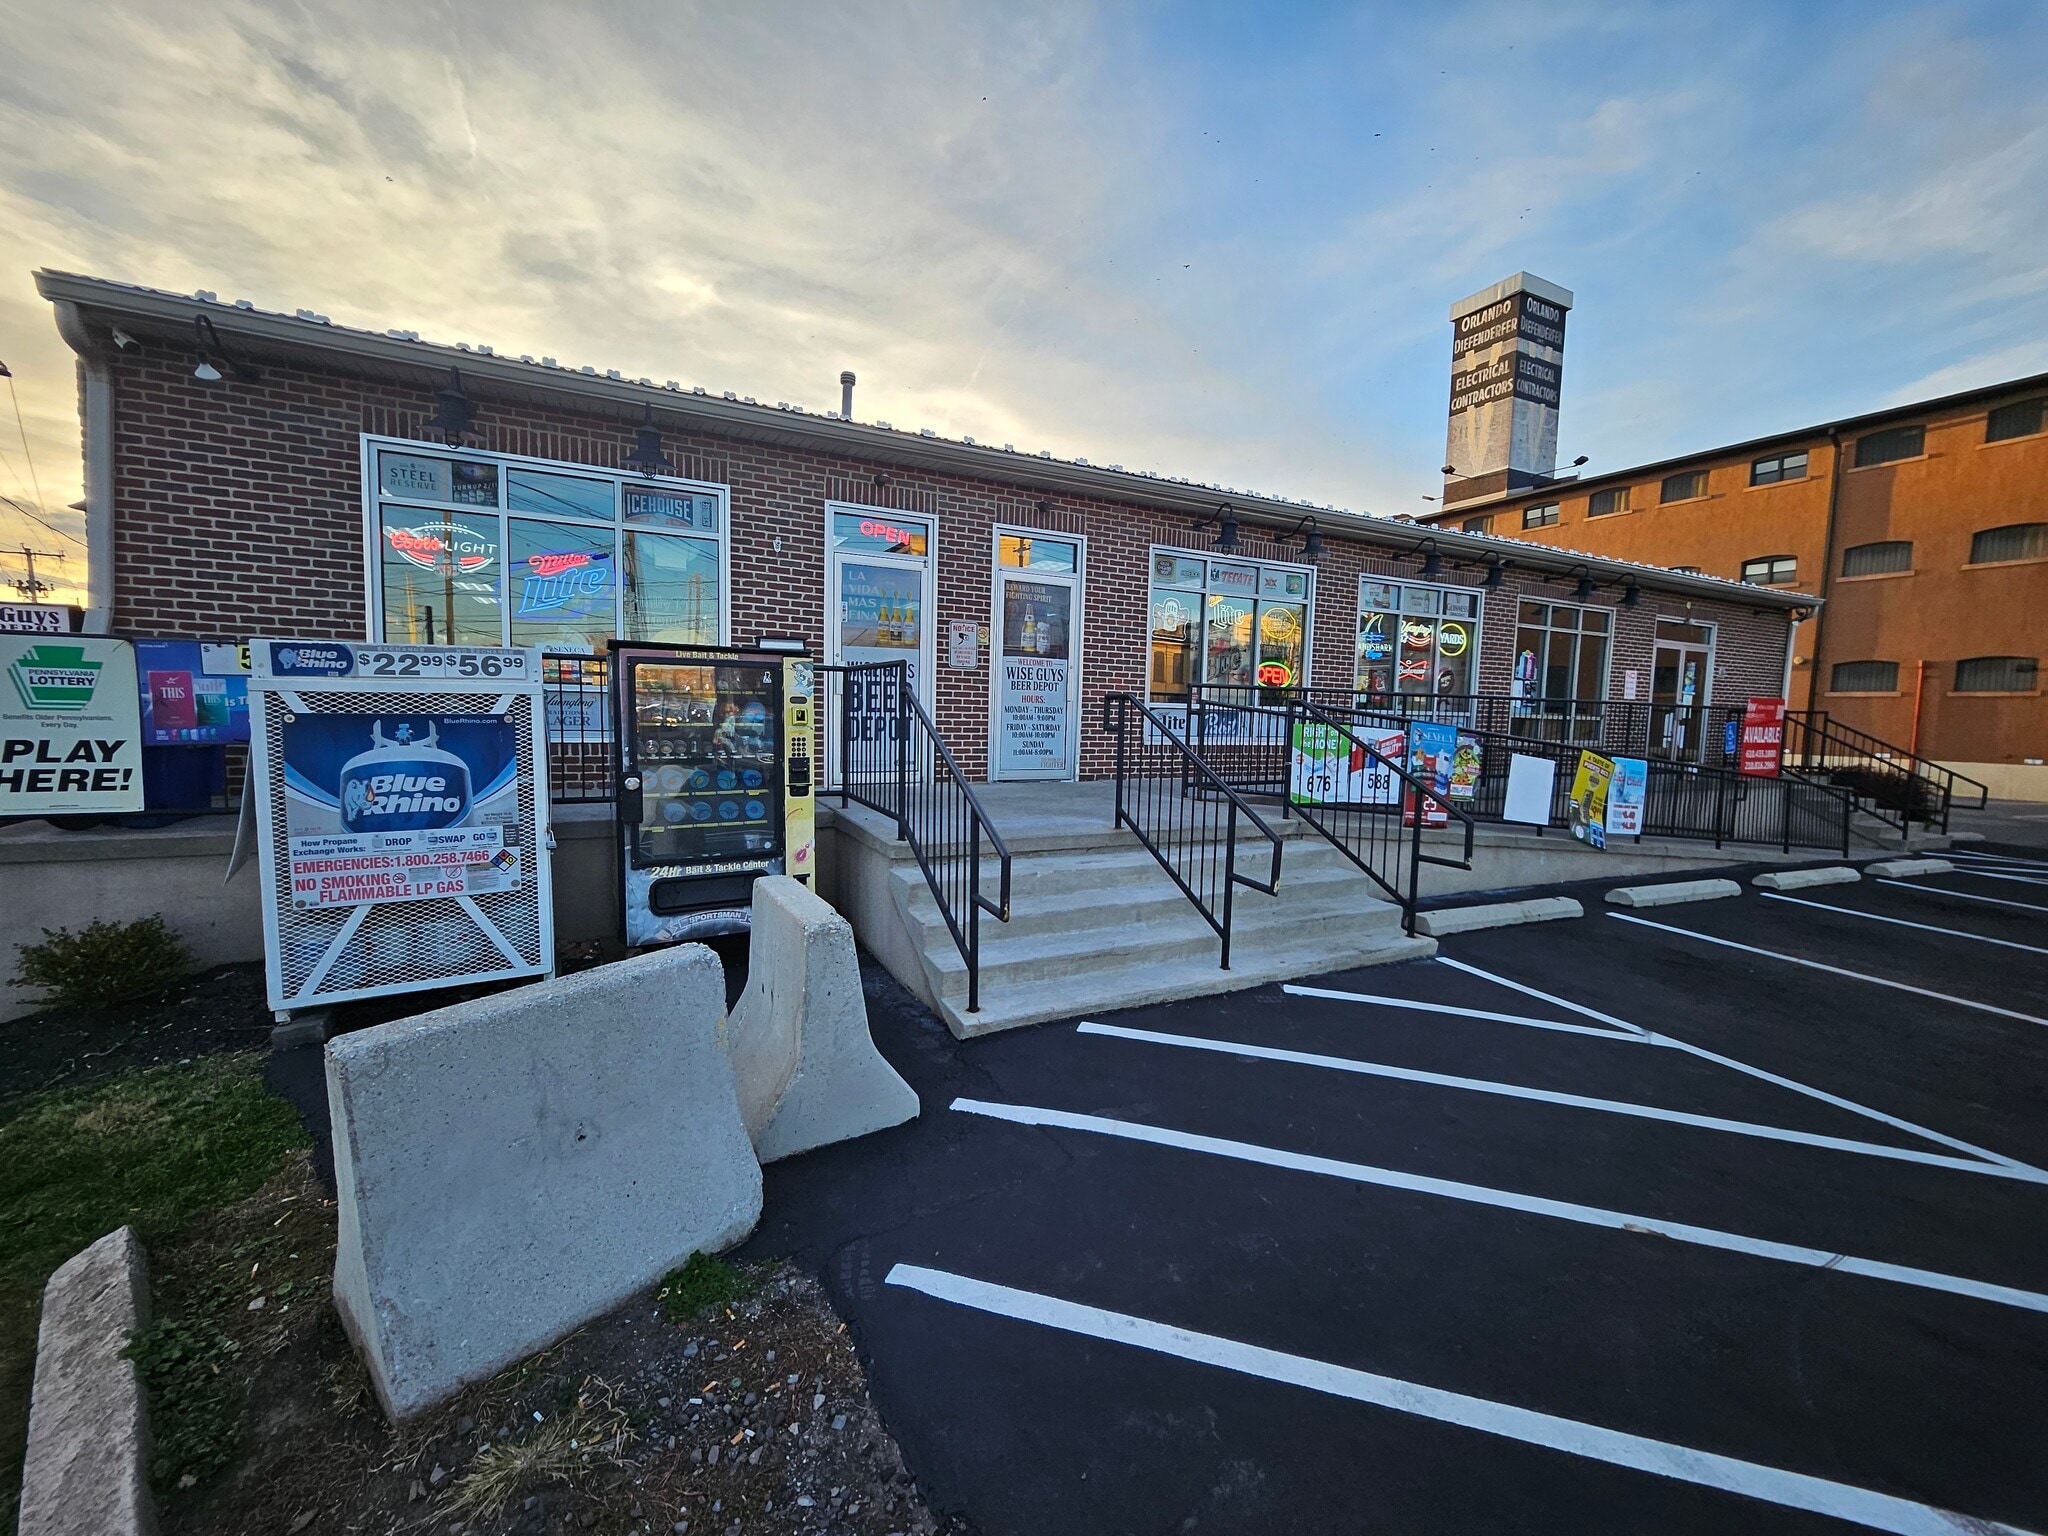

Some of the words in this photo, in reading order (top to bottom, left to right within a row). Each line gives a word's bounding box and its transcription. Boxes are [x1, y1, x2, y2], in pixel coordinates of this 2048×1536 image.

[1461, 300, 1512, 332] ORLANDO
[1527, 297, 1559, 323] ORLANDO
[1454, 317, 1518, 354] DIEFENDERFER
[1520, 315, 1562, 344] DIEFENDERFER
[1455, 360, 1510, 392] ELECTRICAL
[1519, 359, 1555, 383] ELECTRICAL
[1451, 378, 1514, 411] CONTRACTORS
[1516, 379, 1557, 401] CONTRACTORS
[390, 467, 435, 483] STEEL
[390, 479, 437, 491] RESERVE
[626, 493, 692, 521] ICEHOUSE
[860, 521, 911, 546] OPEN
[390, 531, 439, 551] Coors
[445, 541, 497, 554] LIGHT
[528, 553, 591, 575] Miller
[848, 570, 866, 581] LA
[1222, 570, 1254, 585] TECATE
[518, 568, 607, 614] Lite
[848, 584, 880, 596] VIDA
[0, 607, 60, 624] Guys
[848, 610, 879, 621] FINA
[1212, 604, 1245, 630] Lite
[1441, 633, 1464, 645] YARDS
[299, 649, 337, 659] Blue
[1358, 643, 1393, 652] ANDSHARK
[717, 652, 739, 660] Tackle
[1017, 658, 1044, 666] WELCOME
[295, 659, 347, 669] Rhino
[29, 676, 95, 686] LOTTERY
[1006, 666, 1033, 681] WISE
[1036, 668, 1064, 682] GUYS
[1258, 667, 1287, 683] OPEN
[160, 687, 185, 698] THIS
[1011, 681, 1031, 691] BEER
[1033, 682, 1059, 692] DEPOT
[203, 695, 220, 703] THIS
[1021, 695, 1046, 704] HOURS:
[1004, 705, 1028, 714] MONDAY
[1034, 706, 1063, 714] THURSDAY
[1006, 723, 1027, 731] FRIDAY
[1031, 723, 1061, 731] SATURDAY
[1304, 727, 1330, 738] RIGHT
[1423, 733, 1453, 743] SENECA
[1744, 727, 1780, 743] AVAILABLE
[2, 740, 127, 763] PLAY
[1022, 740, 1045, 748] SUNDAY
[1311, 739, 1343, 750] MONEY
[0, 769, 133, 792] HERE!
[371, 774, 446, 793] Blue
[1307, 776, 1331, 793] 676
[1367, 773, 1391, 790] 588
[363, 793, 460, 816] Rhino
[323, 838, 358, 847] Propane
[385, 837, 412, 847] DROP
[438, 834, 466, 844] SWAP
[473, 833, 485, 841] GO
[293, 847, 335, 857] Exchange
[337, 846, 366, 854] Works:
[685, 866, 703, 875] Bait
[705, 865, 713, 873] &
[714, 863, 741, 872] Tackle
[743, 860, 769, 869] Center
[295, 878, 317, 892] NO
[321, 873, 391, 890] SMOKING
[320, 884, 412, 903] FLAMMABLE
[416, 882, 433, 896] LP
[436, 880, 464, 893] GAS
[689, 911, 742, 924] SPORTSMAN
